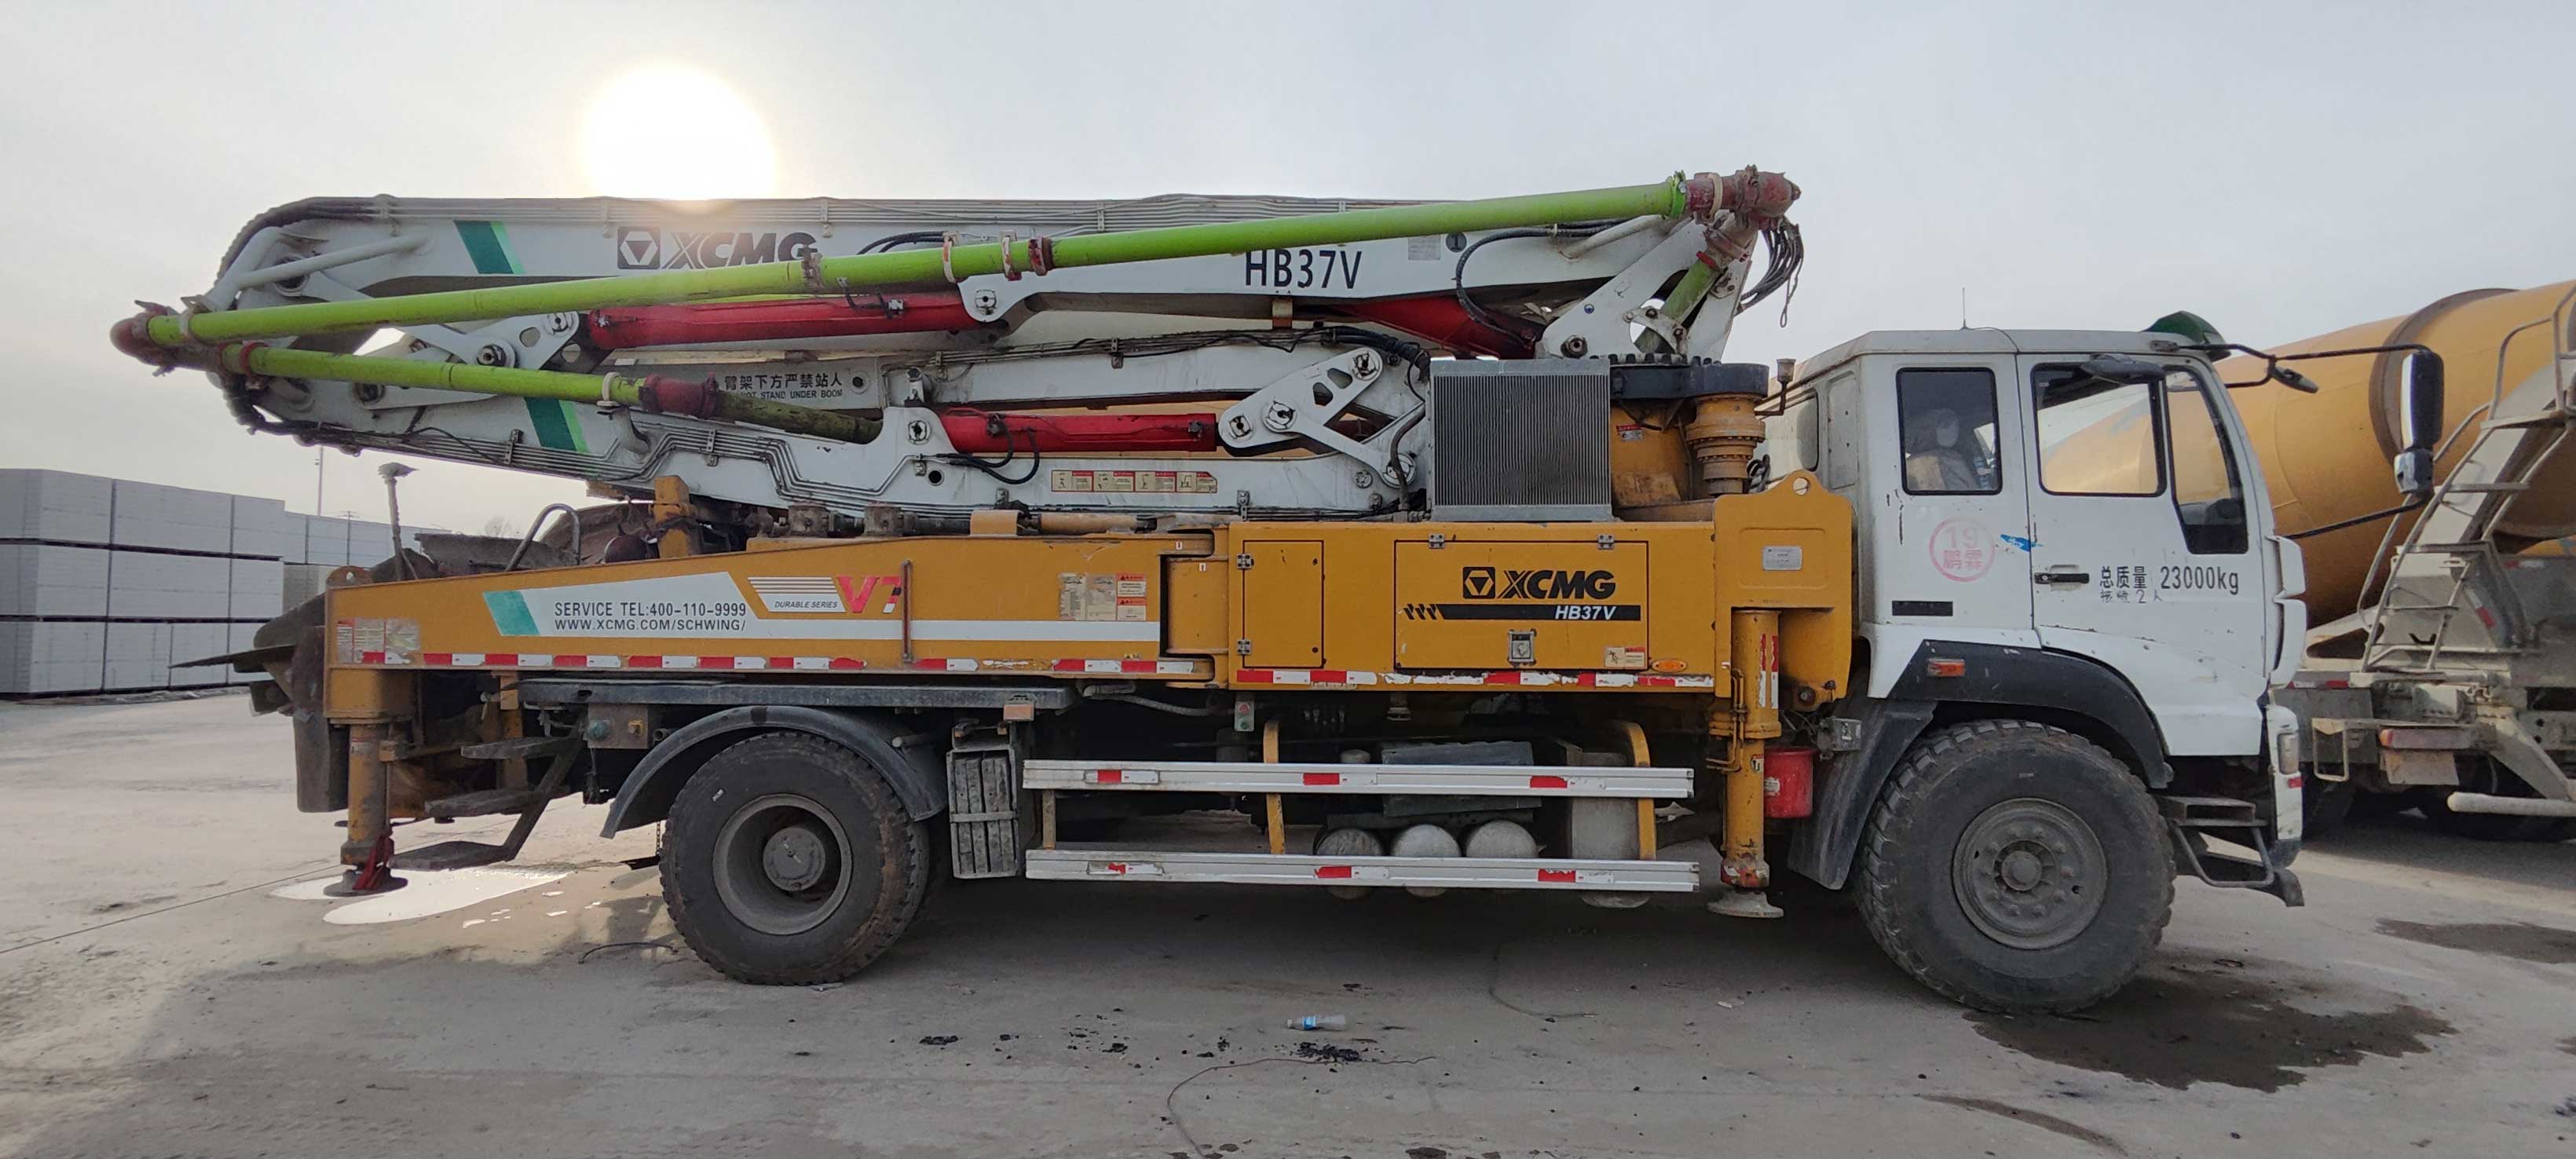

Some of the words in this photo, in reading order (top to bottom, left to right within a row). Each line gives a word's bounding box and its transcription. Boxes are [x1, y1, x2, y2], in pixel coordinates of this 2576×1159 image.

[663, 232, 818, 269] XCMG
[1246, 249, 1362, 289] HB37V
[724, 373, 843, 390] 臂架下方严禁站人
[790, 390, 817, 399] UNDER
[821, 389, 843, 398] BOOM
[1497, 570, 1616, 599] XCMG
[2099, 565, 2147, 589] 总质量
[2160, 565, 2238, 595] 23000kg
[837, 575, 902, 613] V7
[554, 602, 613, 616] SERVICE
[620, 602, 746, 616] TEL:400-110-9999
[1554, 605, 1616, 620] HB37V
[554, 620, 746, 631] WWW.XCMG.COM/SCHWING/
